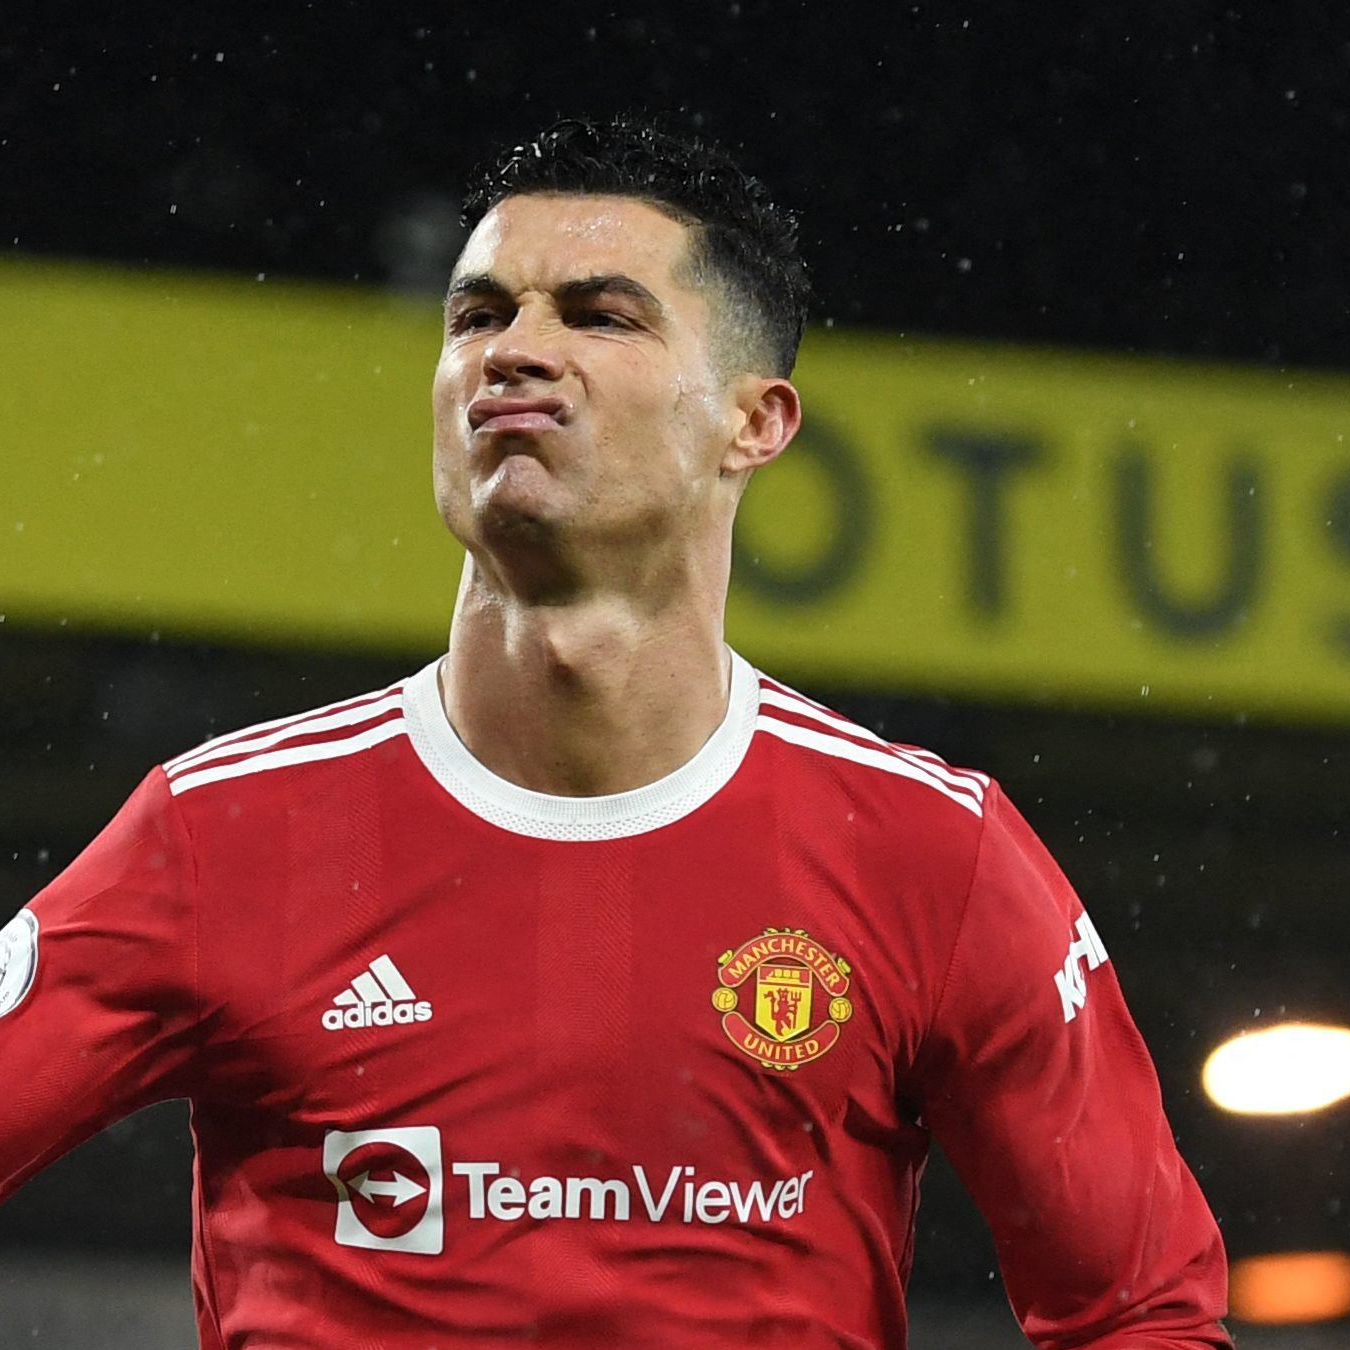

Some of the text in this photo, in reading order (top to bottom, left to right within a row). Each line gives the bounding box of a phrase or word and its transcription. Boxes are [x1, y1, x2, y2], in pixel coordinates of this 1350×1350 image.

[322, 999, 434, 1031] adidas
[727, 938, 841, 1061] MANCHESTER UNITED
[451, 1162, 815, 1226] TeamViewer
